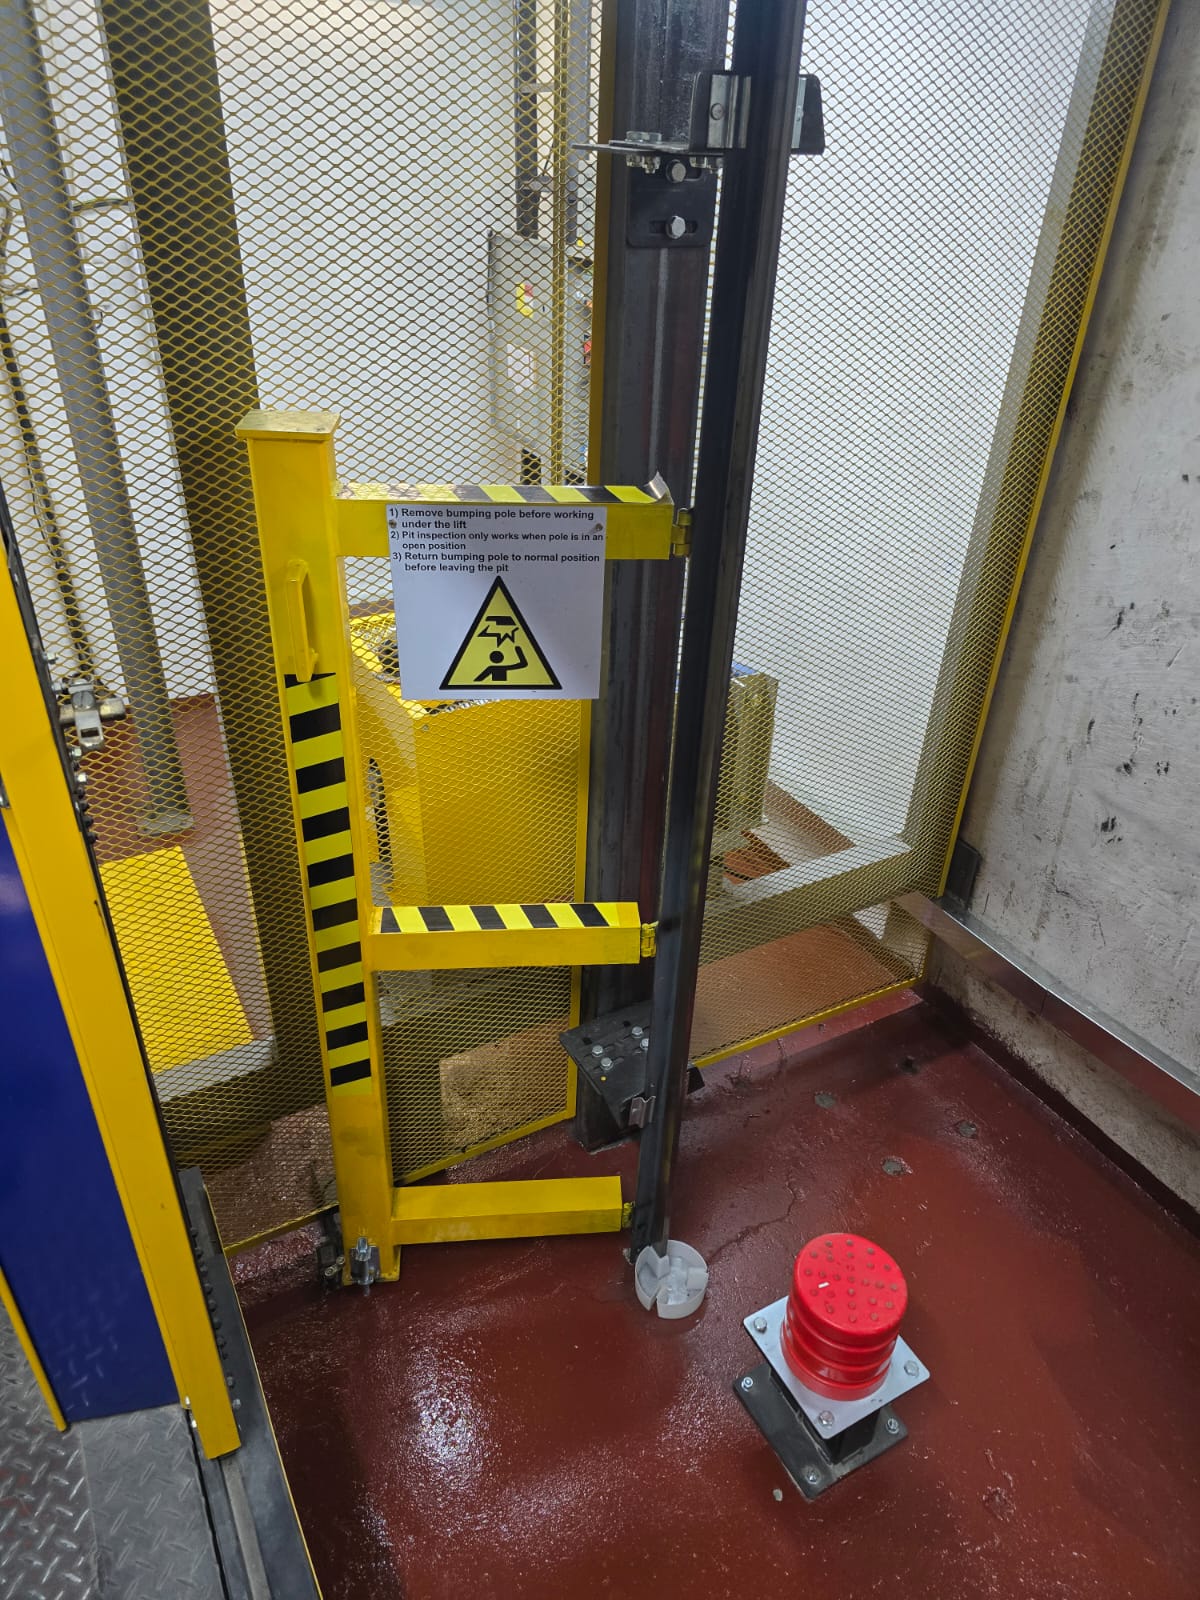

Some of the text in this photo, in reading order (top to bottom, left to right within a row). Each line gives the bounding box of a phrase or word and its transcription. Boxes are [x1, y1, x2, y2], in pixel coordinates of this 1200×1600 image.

[389, 508, 594, 519] 1) Remove bumping pole before working
[402, 520, 467, 529] under the lift
[390, 531, 400, 540] 2)
[402, 531, 414, 539] Pit
[417, 532, 466, 541] inspection
[468, 532, 489, 541] only
[549, 533, 569, 541] pole
[581, 533, 590, 541] in
[402, 542, 466, 550] open position
[392, 553, 402, 562] 3)
[405, 553, 439, 561] Return
[441, 553, 485, 562] bumping
[487, 553, 509, 562] pole
[524, 554, 558, 562] normal
[561, 554, 600, 562] position
[405, 563, 509, 572] before leaving the pit
